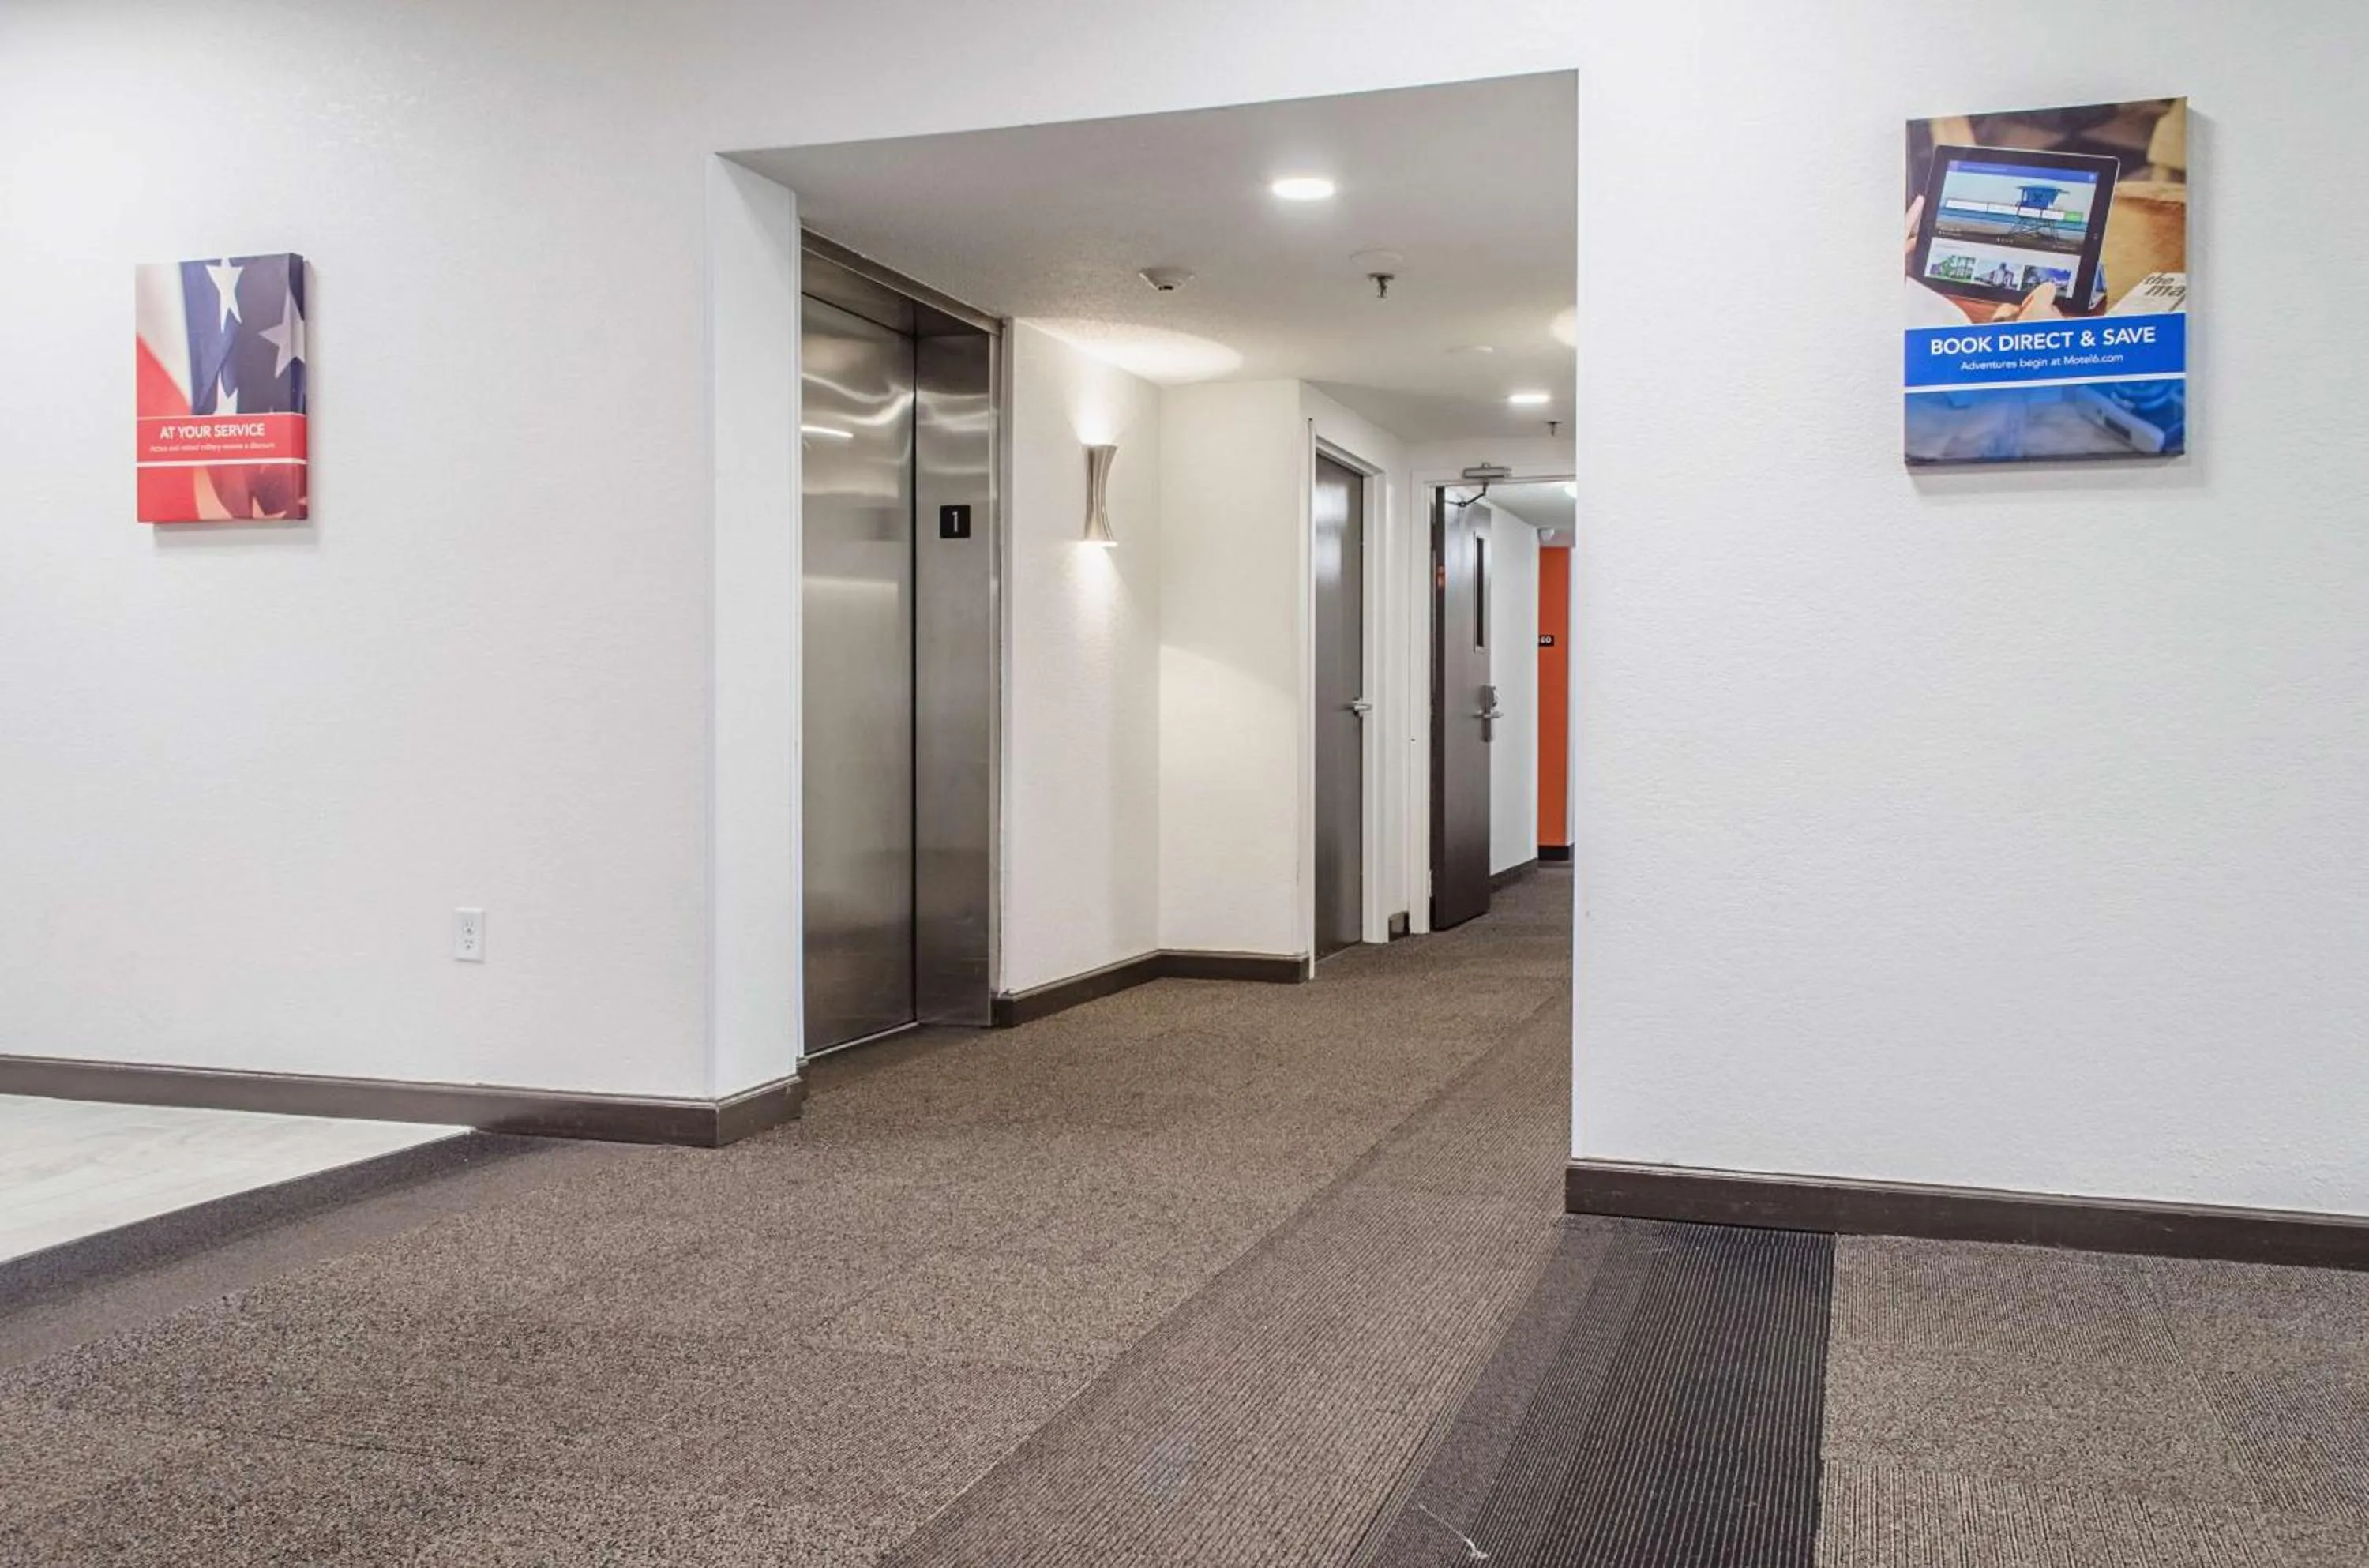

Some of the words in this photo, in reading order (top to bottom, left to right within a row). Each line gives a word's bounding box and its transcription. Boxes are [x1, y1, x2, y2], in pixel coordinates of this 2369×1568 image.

[1931, 336, 1992, 355] BOOK
[1999, 331, 2074, 351] DIRECT
[2079, 329, 2096, 347] &
[2102, 326, 2157, 346] SAVE
[1960, 359, 2017, 371] Adventures
[2019, 358, 2048, 370] begin
[2050, 357, 2061, 366] at
[2063, 354, 2123, 366] Motel6.com
[160, 426, 175, 439] AT
[176, 425, 212, 439] YOUR
[214, 423, 265, 437] SERVICE
[952, 511, 958, 532] 1
